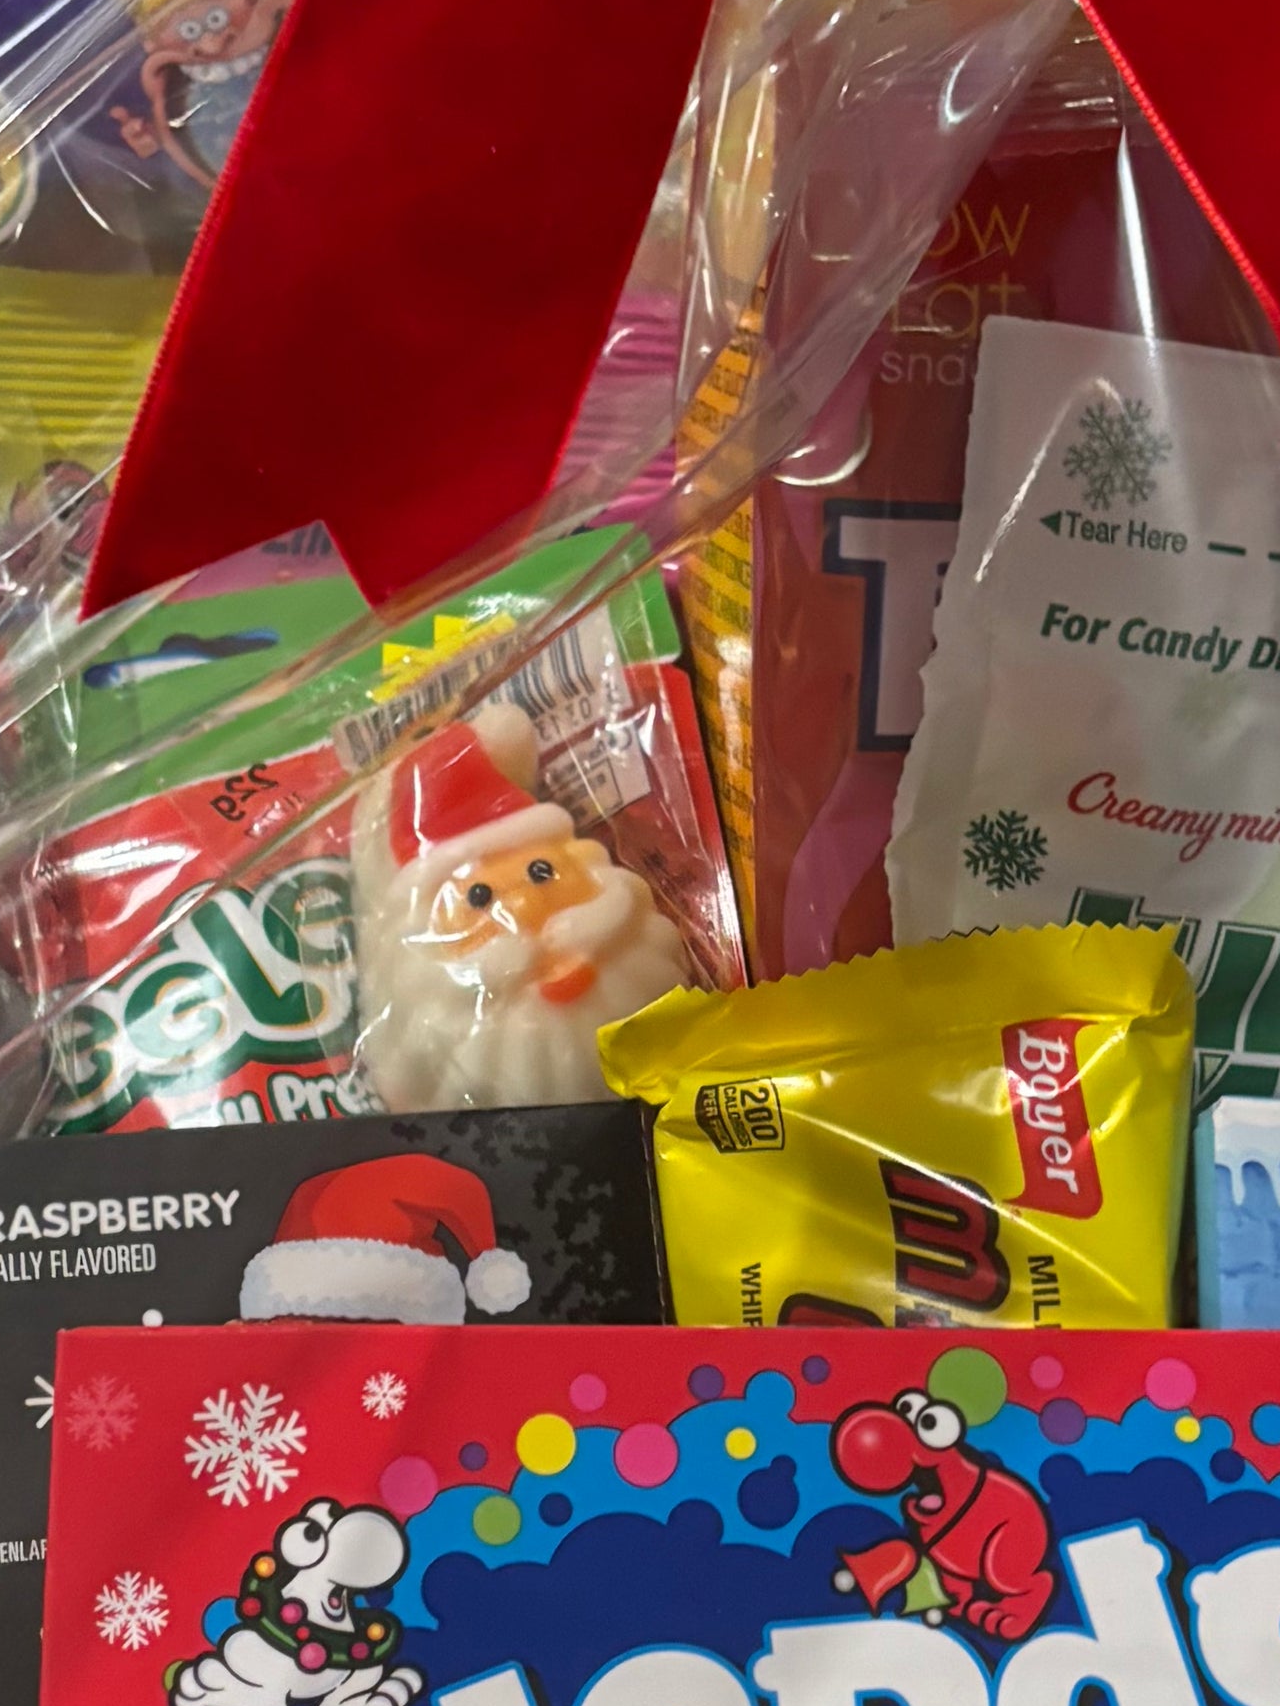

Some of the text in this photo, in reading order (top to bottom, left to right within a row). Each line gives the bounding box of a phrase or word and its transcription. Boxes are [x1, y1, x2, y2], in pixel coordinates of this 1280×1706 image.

[1066, 510, 1188, 554] Tear Here
[1040, 602, 1111, 644] For
[1118, 617, 1242, 672] Candy
[1067, 771, 1222, 863] Creamy
[740, 1086, 779, 1141] 200
[1017, 1026, 1081, 1196] Boyer
[50, 1242, 157, 1278] FLAVORED
[1027, 1254, 1062, 1329] MIL
